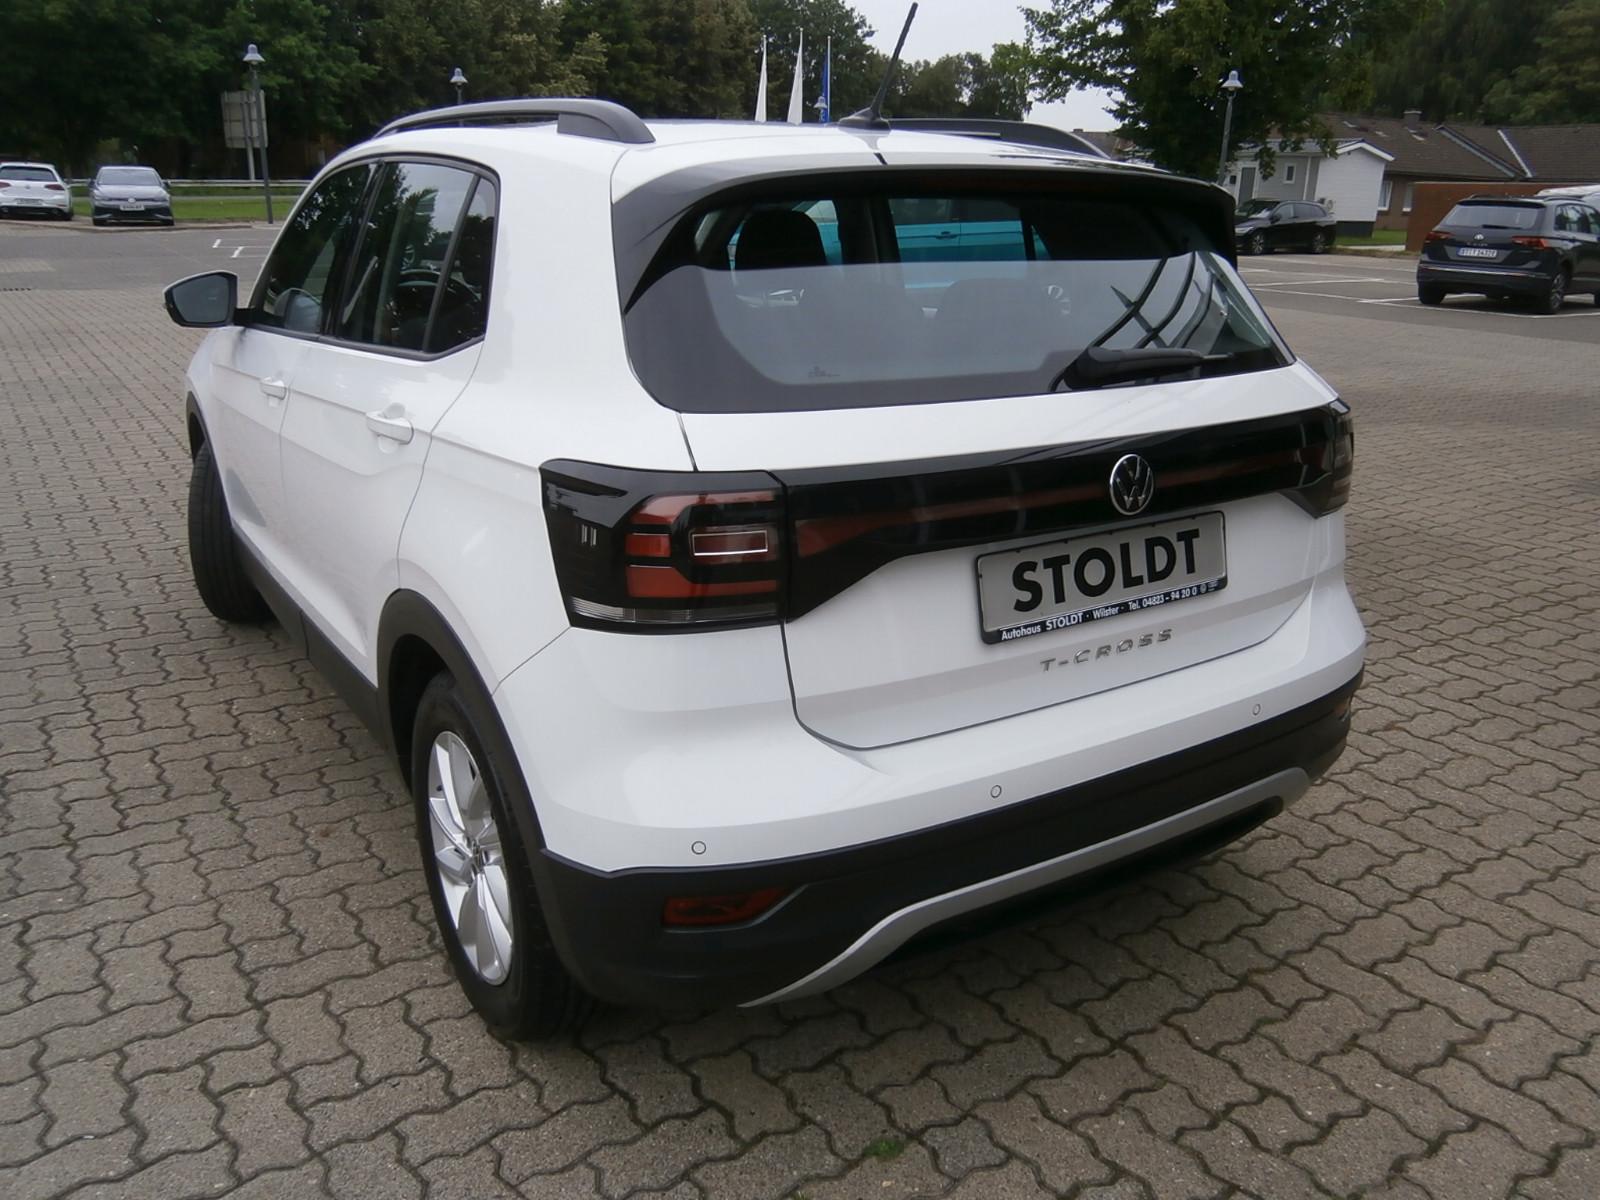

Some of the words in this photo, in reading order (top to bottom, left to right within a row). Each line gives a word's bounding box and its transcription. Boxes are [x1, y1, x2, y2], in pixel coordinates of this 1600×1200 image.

[1012, 528, 1200, 613] STOLDT
[1001, 624, 1042, 641] Autohaus
[1045, 613, 1084, 630] STOLDT
[1092, 605, 1120, 620] Wilster
[1128, 600, 1141, 611] Tel.
[1039, 628, 1174, 673] T-CROSS
